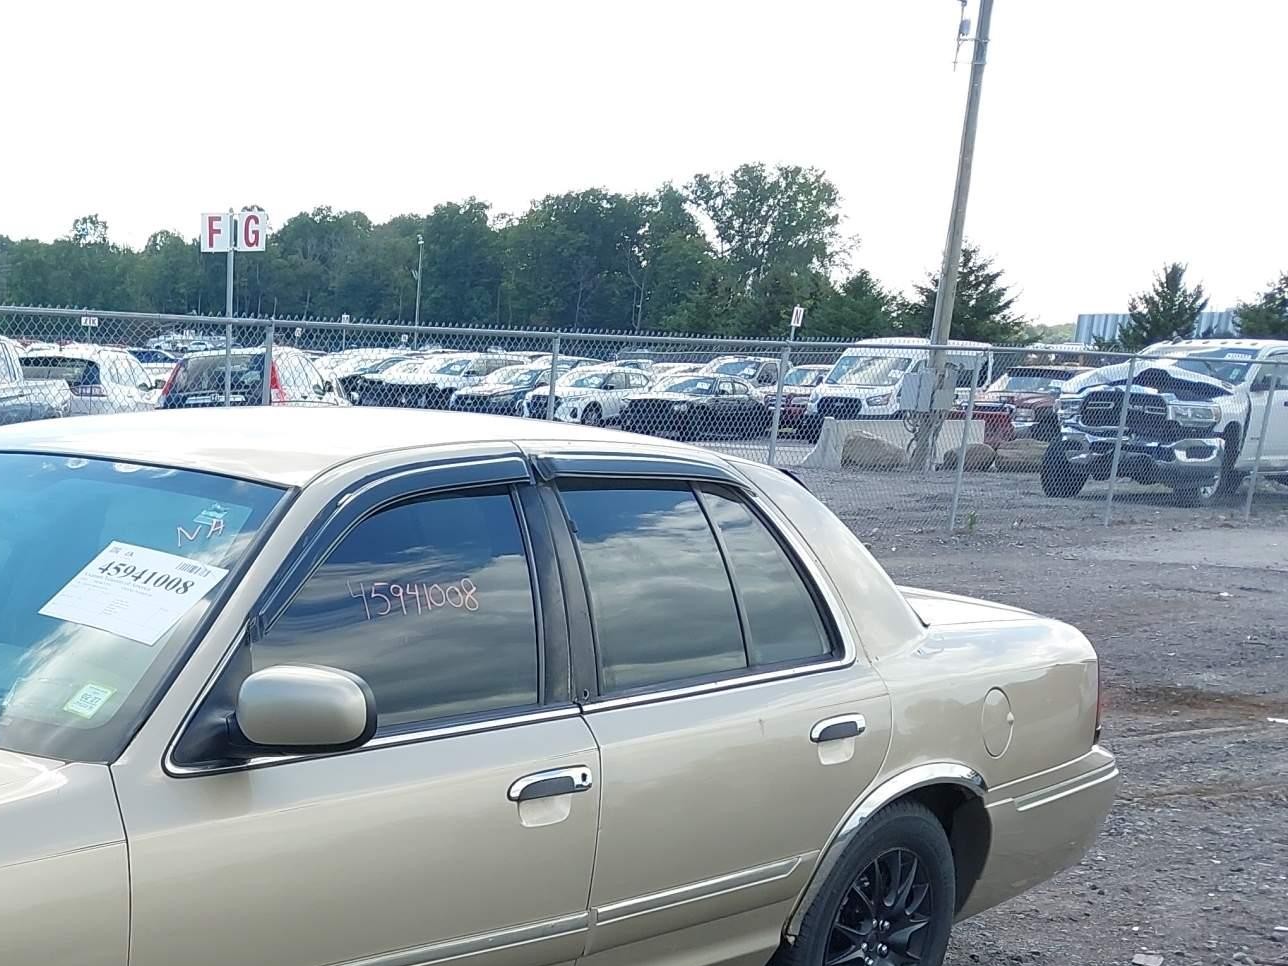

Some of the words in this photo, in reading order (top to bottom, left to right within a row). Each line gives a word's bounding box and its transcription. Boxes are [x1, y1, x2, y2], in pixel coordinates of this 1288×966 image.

[208, 216, 221, 248] F
[244, 215, 259, 247] G
[793, 309, 802, 324] N
[98, 561, 195, 594] 45941008
[345, 577, 479, 620] 45941008
